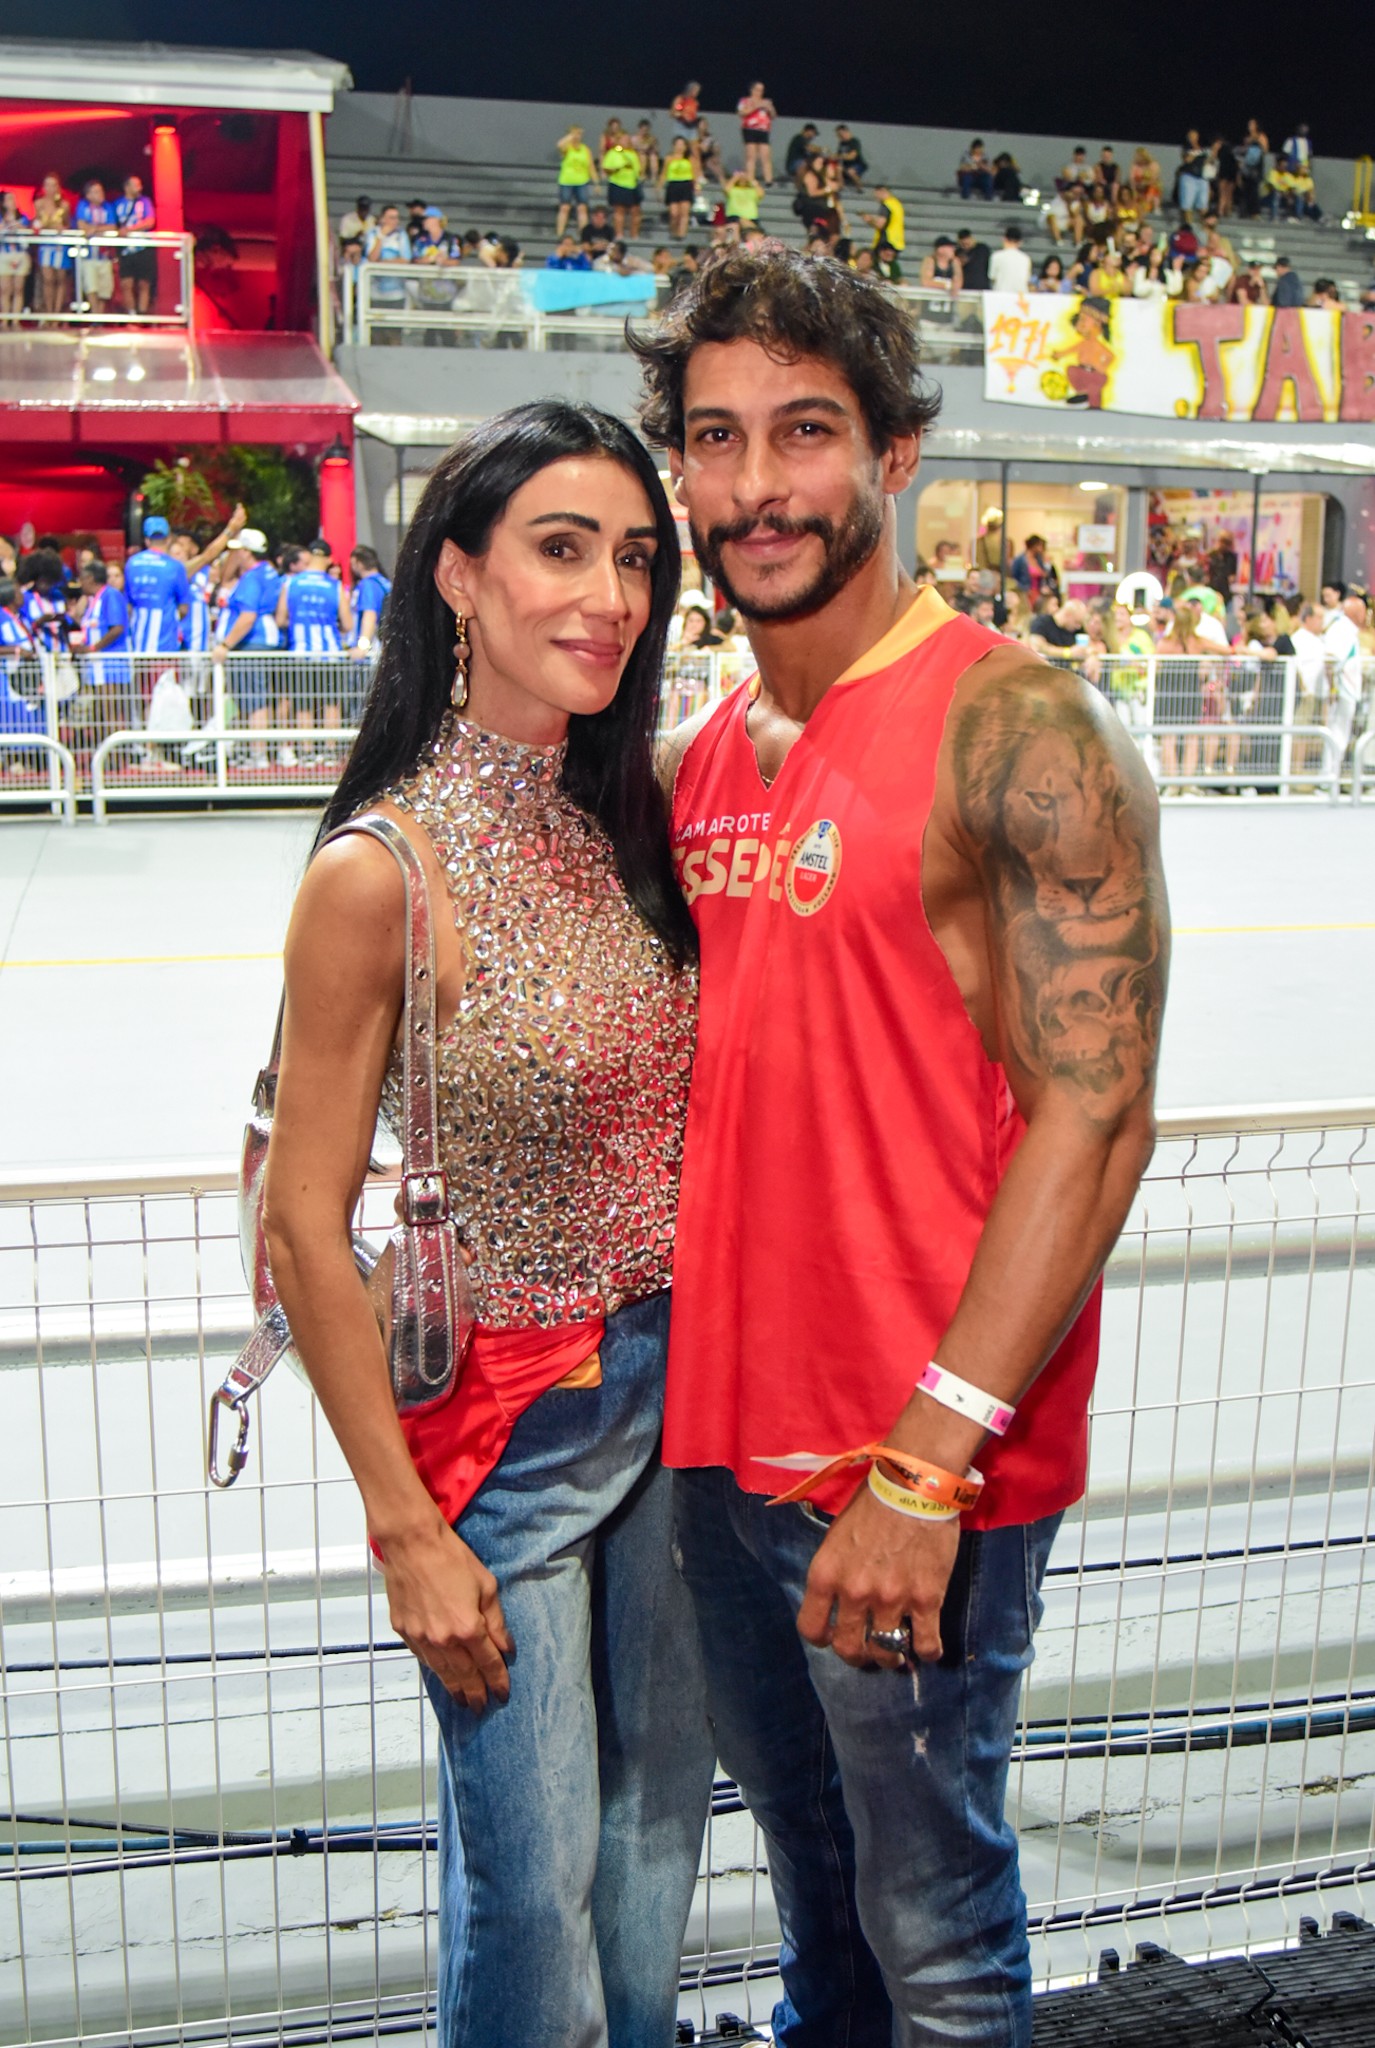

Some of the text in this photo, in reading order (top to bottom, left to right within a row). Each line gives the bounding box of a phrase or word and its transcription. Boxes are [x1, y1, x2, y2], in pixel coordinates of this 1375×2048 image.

[988, 313, 1051, 361] 1971
[675, 812, 771, 842] CAMAROTE
[800, 852, 828, 870] AMSTEL
[899, 1496, 918, 1508] VIP
